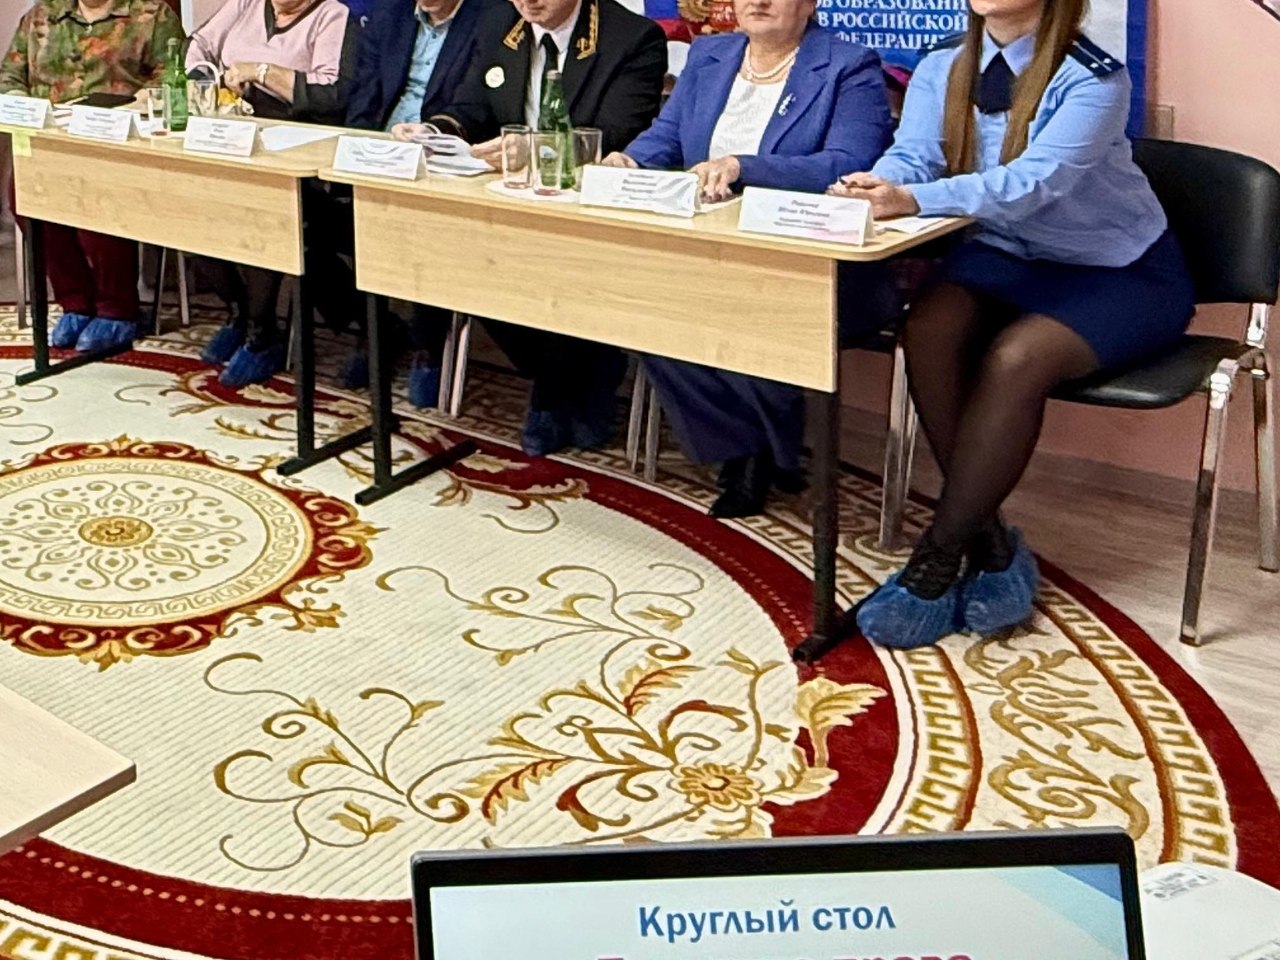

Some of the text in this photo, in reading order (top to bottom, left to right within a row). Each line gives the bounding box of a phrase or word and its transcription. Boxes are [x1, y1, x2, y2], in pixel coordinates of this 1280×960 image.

[817, 10, 969, 32] В РОССИЙСКОЙ
[639, 899, 897, 943] Круглый стол
